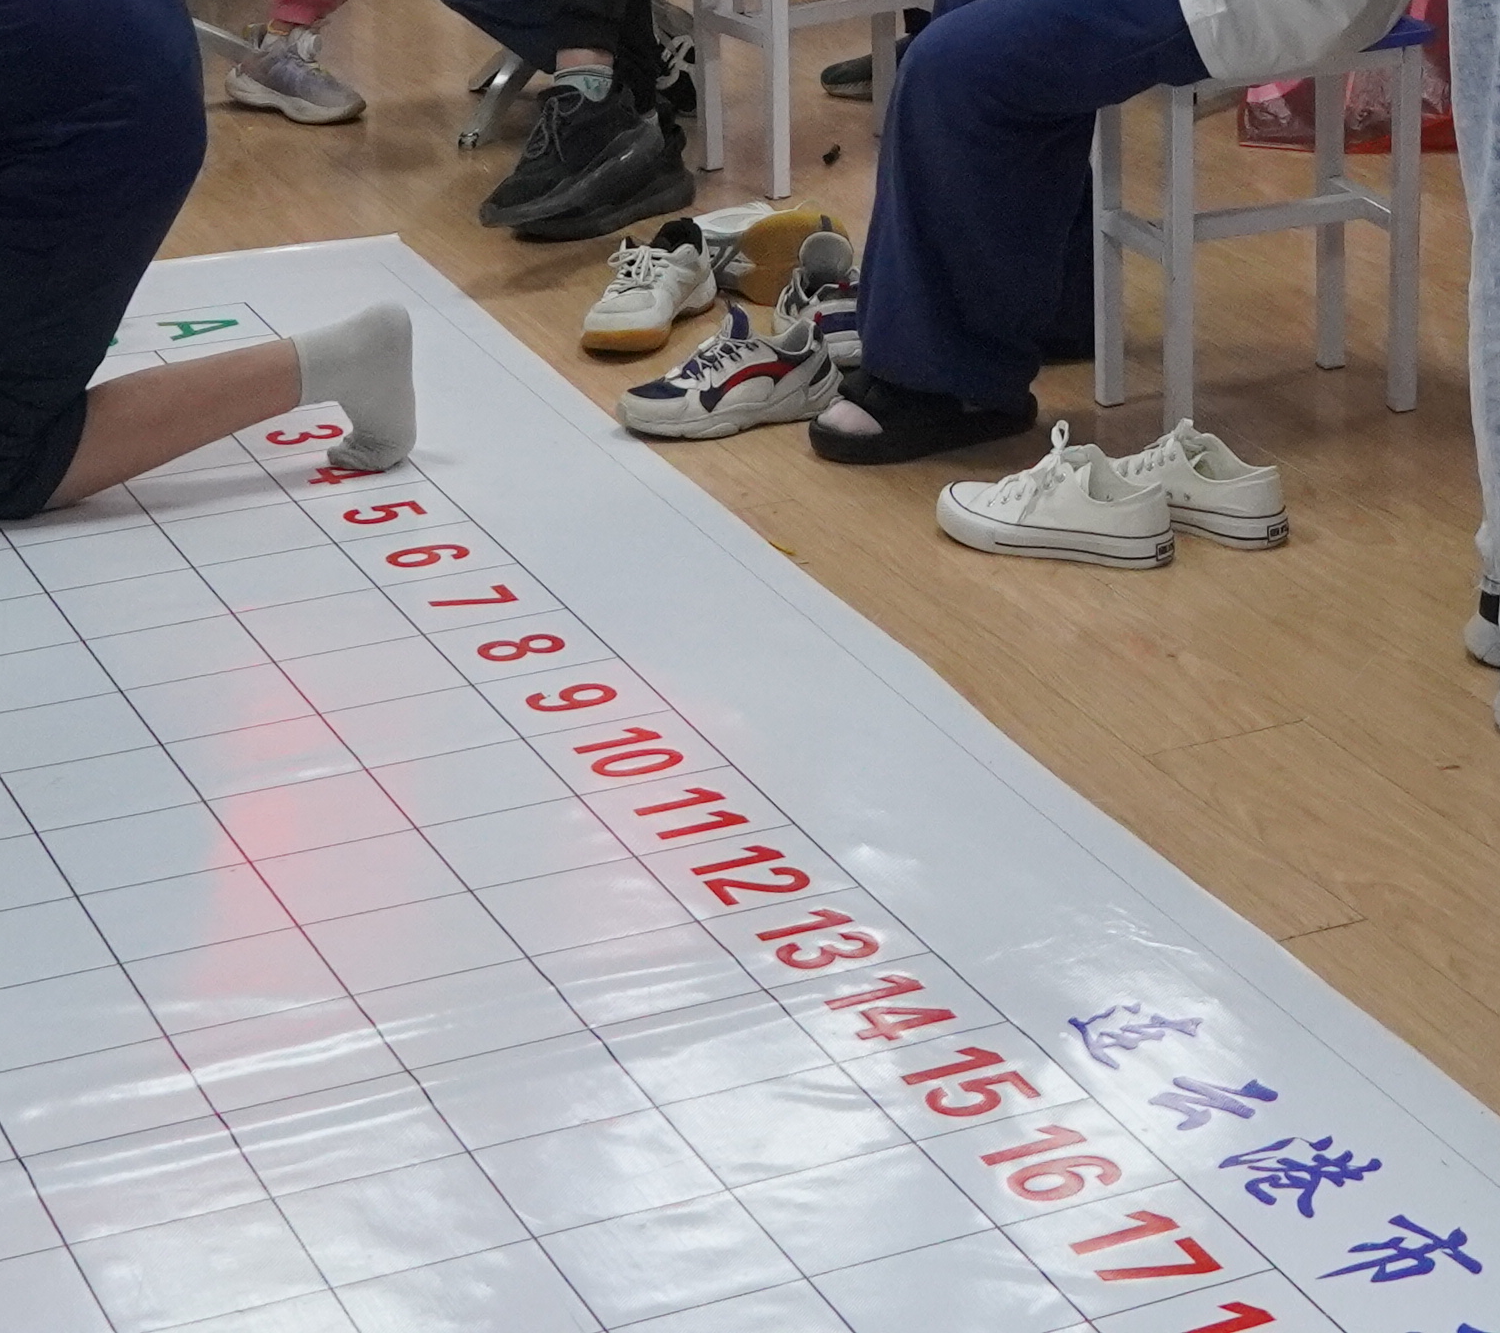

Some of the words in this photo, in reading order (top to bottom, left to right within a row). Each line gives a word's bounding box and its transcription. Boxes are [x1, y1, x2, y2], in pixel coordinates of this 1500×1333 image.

[157, 319, 239, 342] A
[265, 423, 344, 446] 3
[342, 500, 427, 525] 5
[385, 543, 470, 568] 6
[429, 584, 518, 608] 7
[476, 633, 566, 662] 8
[524, 683, 618, 712] 9
[573, 727, 685, 778] 10
[634, 787, 750, 841] 11
[690, 845, 811, 907] 12
[756, 909, 880, 970] 13
[823, 974, 957, 1041] 14
[901, 1046, 1041, 1118] 15
[979, 1124, 1122, 1202] 16
[1069, 1210, 1224, 1282] 17
